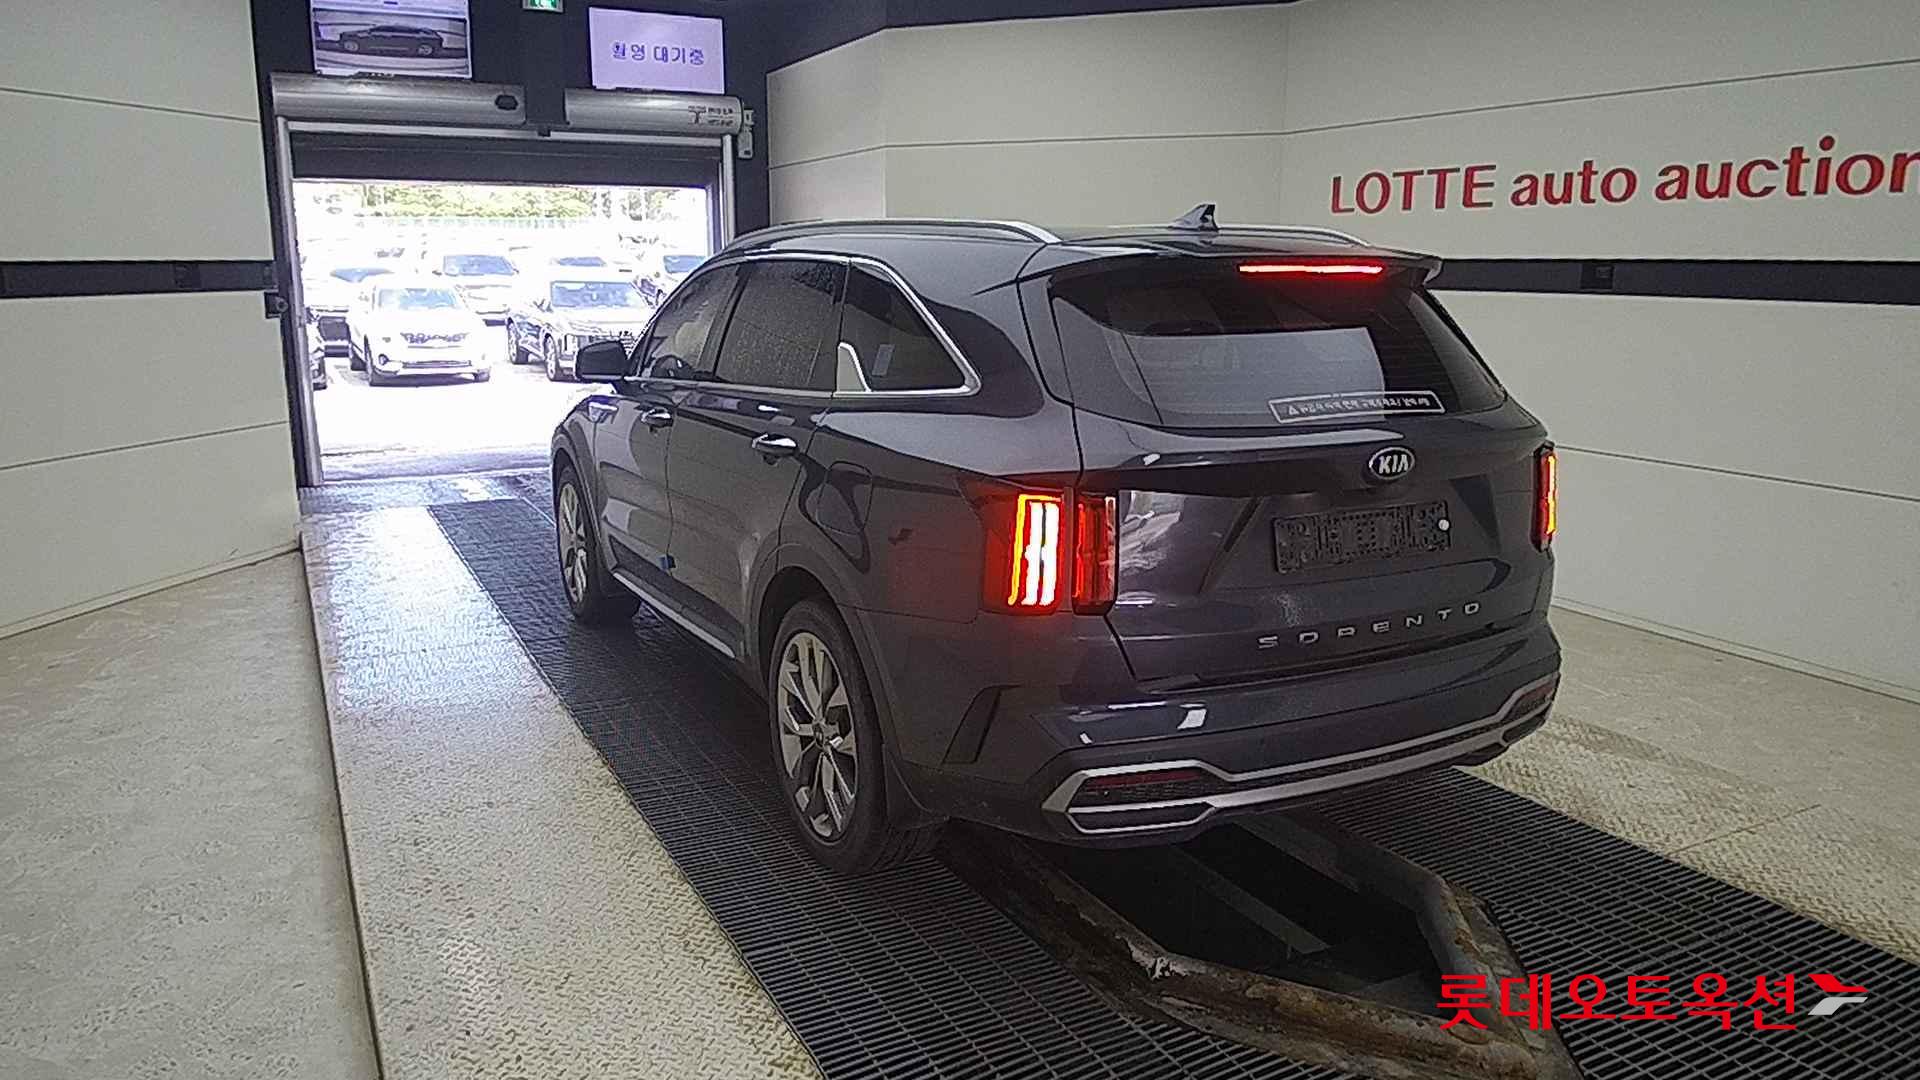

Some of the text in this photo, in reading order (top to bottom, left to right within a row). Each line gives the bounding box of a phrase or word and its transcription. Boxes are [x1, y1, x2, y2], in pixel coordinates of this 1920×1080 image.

[1331, 164, 1497, 214] LOTTE
[1511, 159, 1638, 206] auto
[1378, 455, 1409, 474] KIA
[1258, 603, 1480, 649] SORENTO
